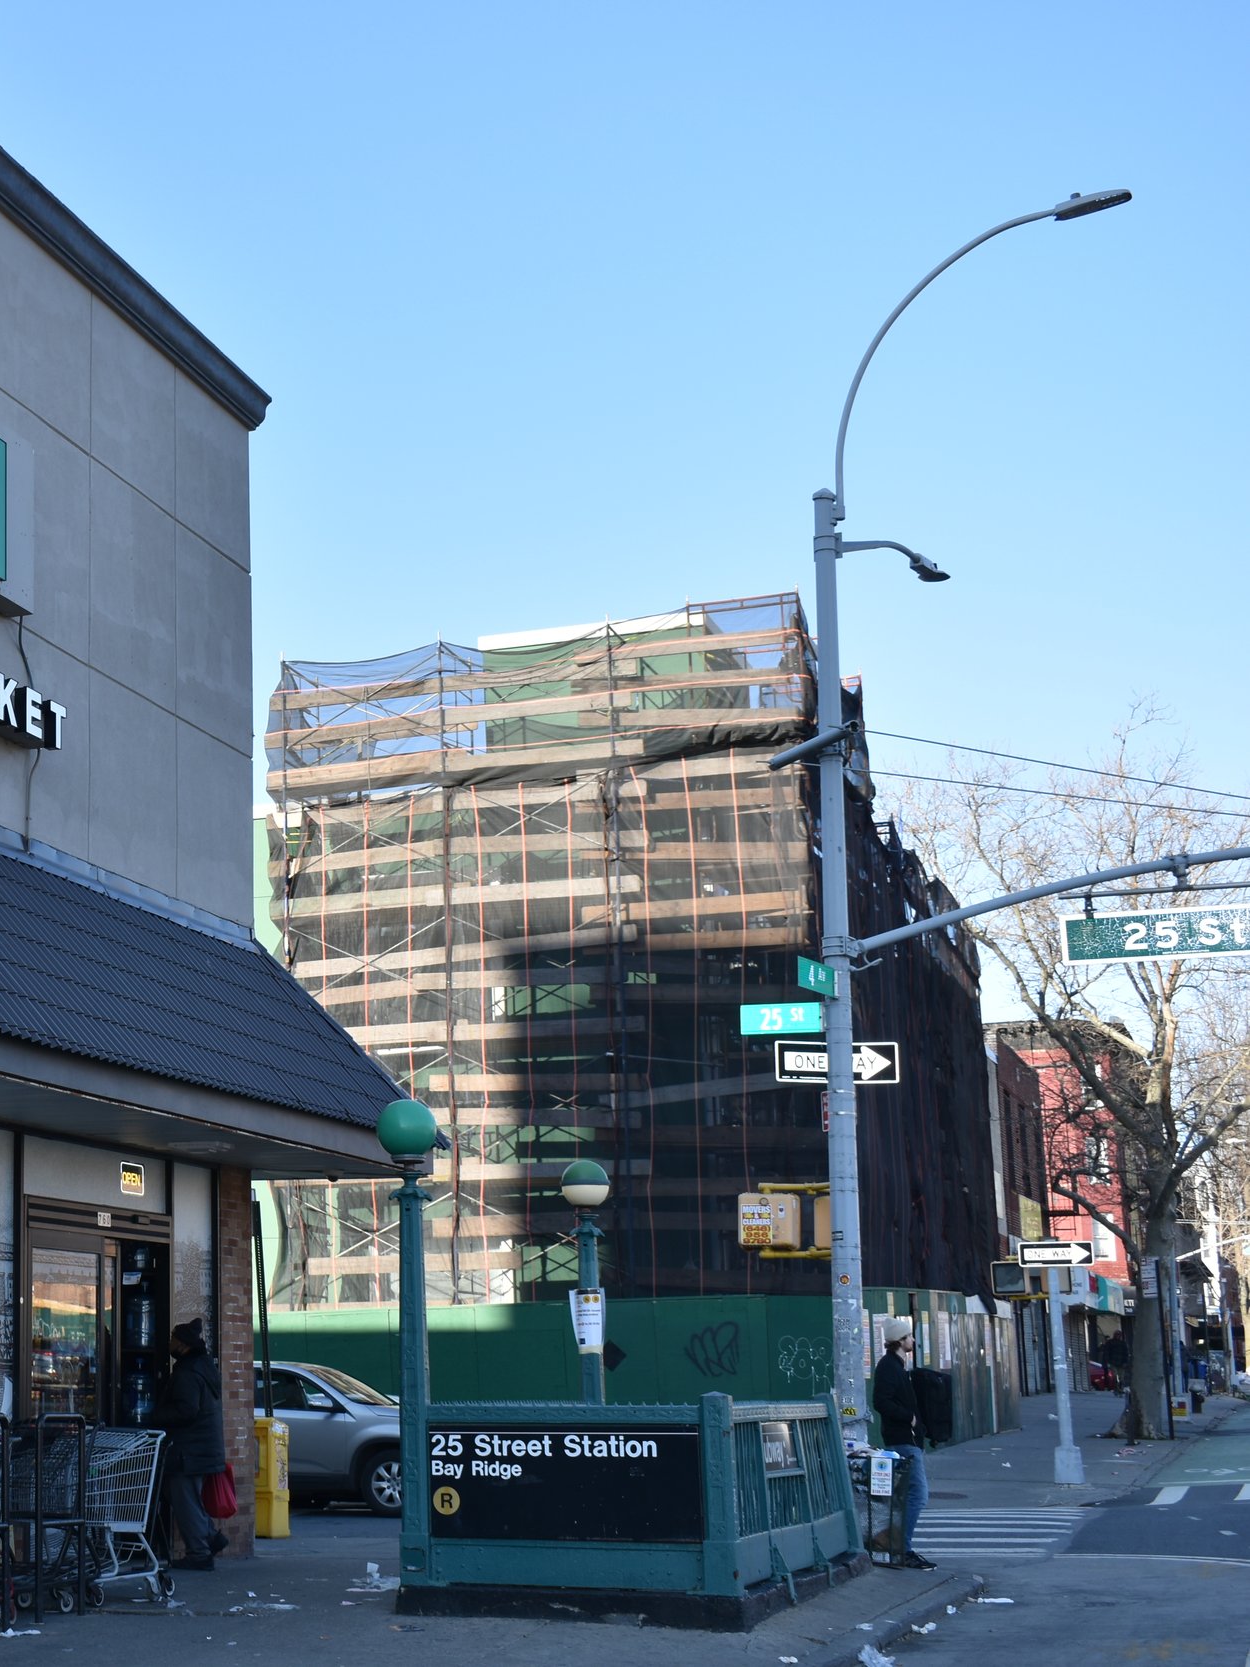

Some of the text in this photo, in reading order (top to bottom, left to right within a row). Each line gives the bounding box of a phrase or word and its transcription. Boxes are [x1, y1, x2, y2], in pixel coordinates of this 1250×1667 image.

[1123, 917, 1247, 950] 25 St
[759, 1007, 805, 1031] 25 St
[794, 1055, 878, 1070] ONE AY
[122, 1171, 141, 1187] OPEN
[1027, 1248, 1071, 1259] ONE WAY
[431, 1434, 658, 1458] 25 Street Station
[762, 1435, 785, 1469] ubway
[431, 1460, 522, 1480] Bay Ridge
[440, 1493, 453, 1509] R
